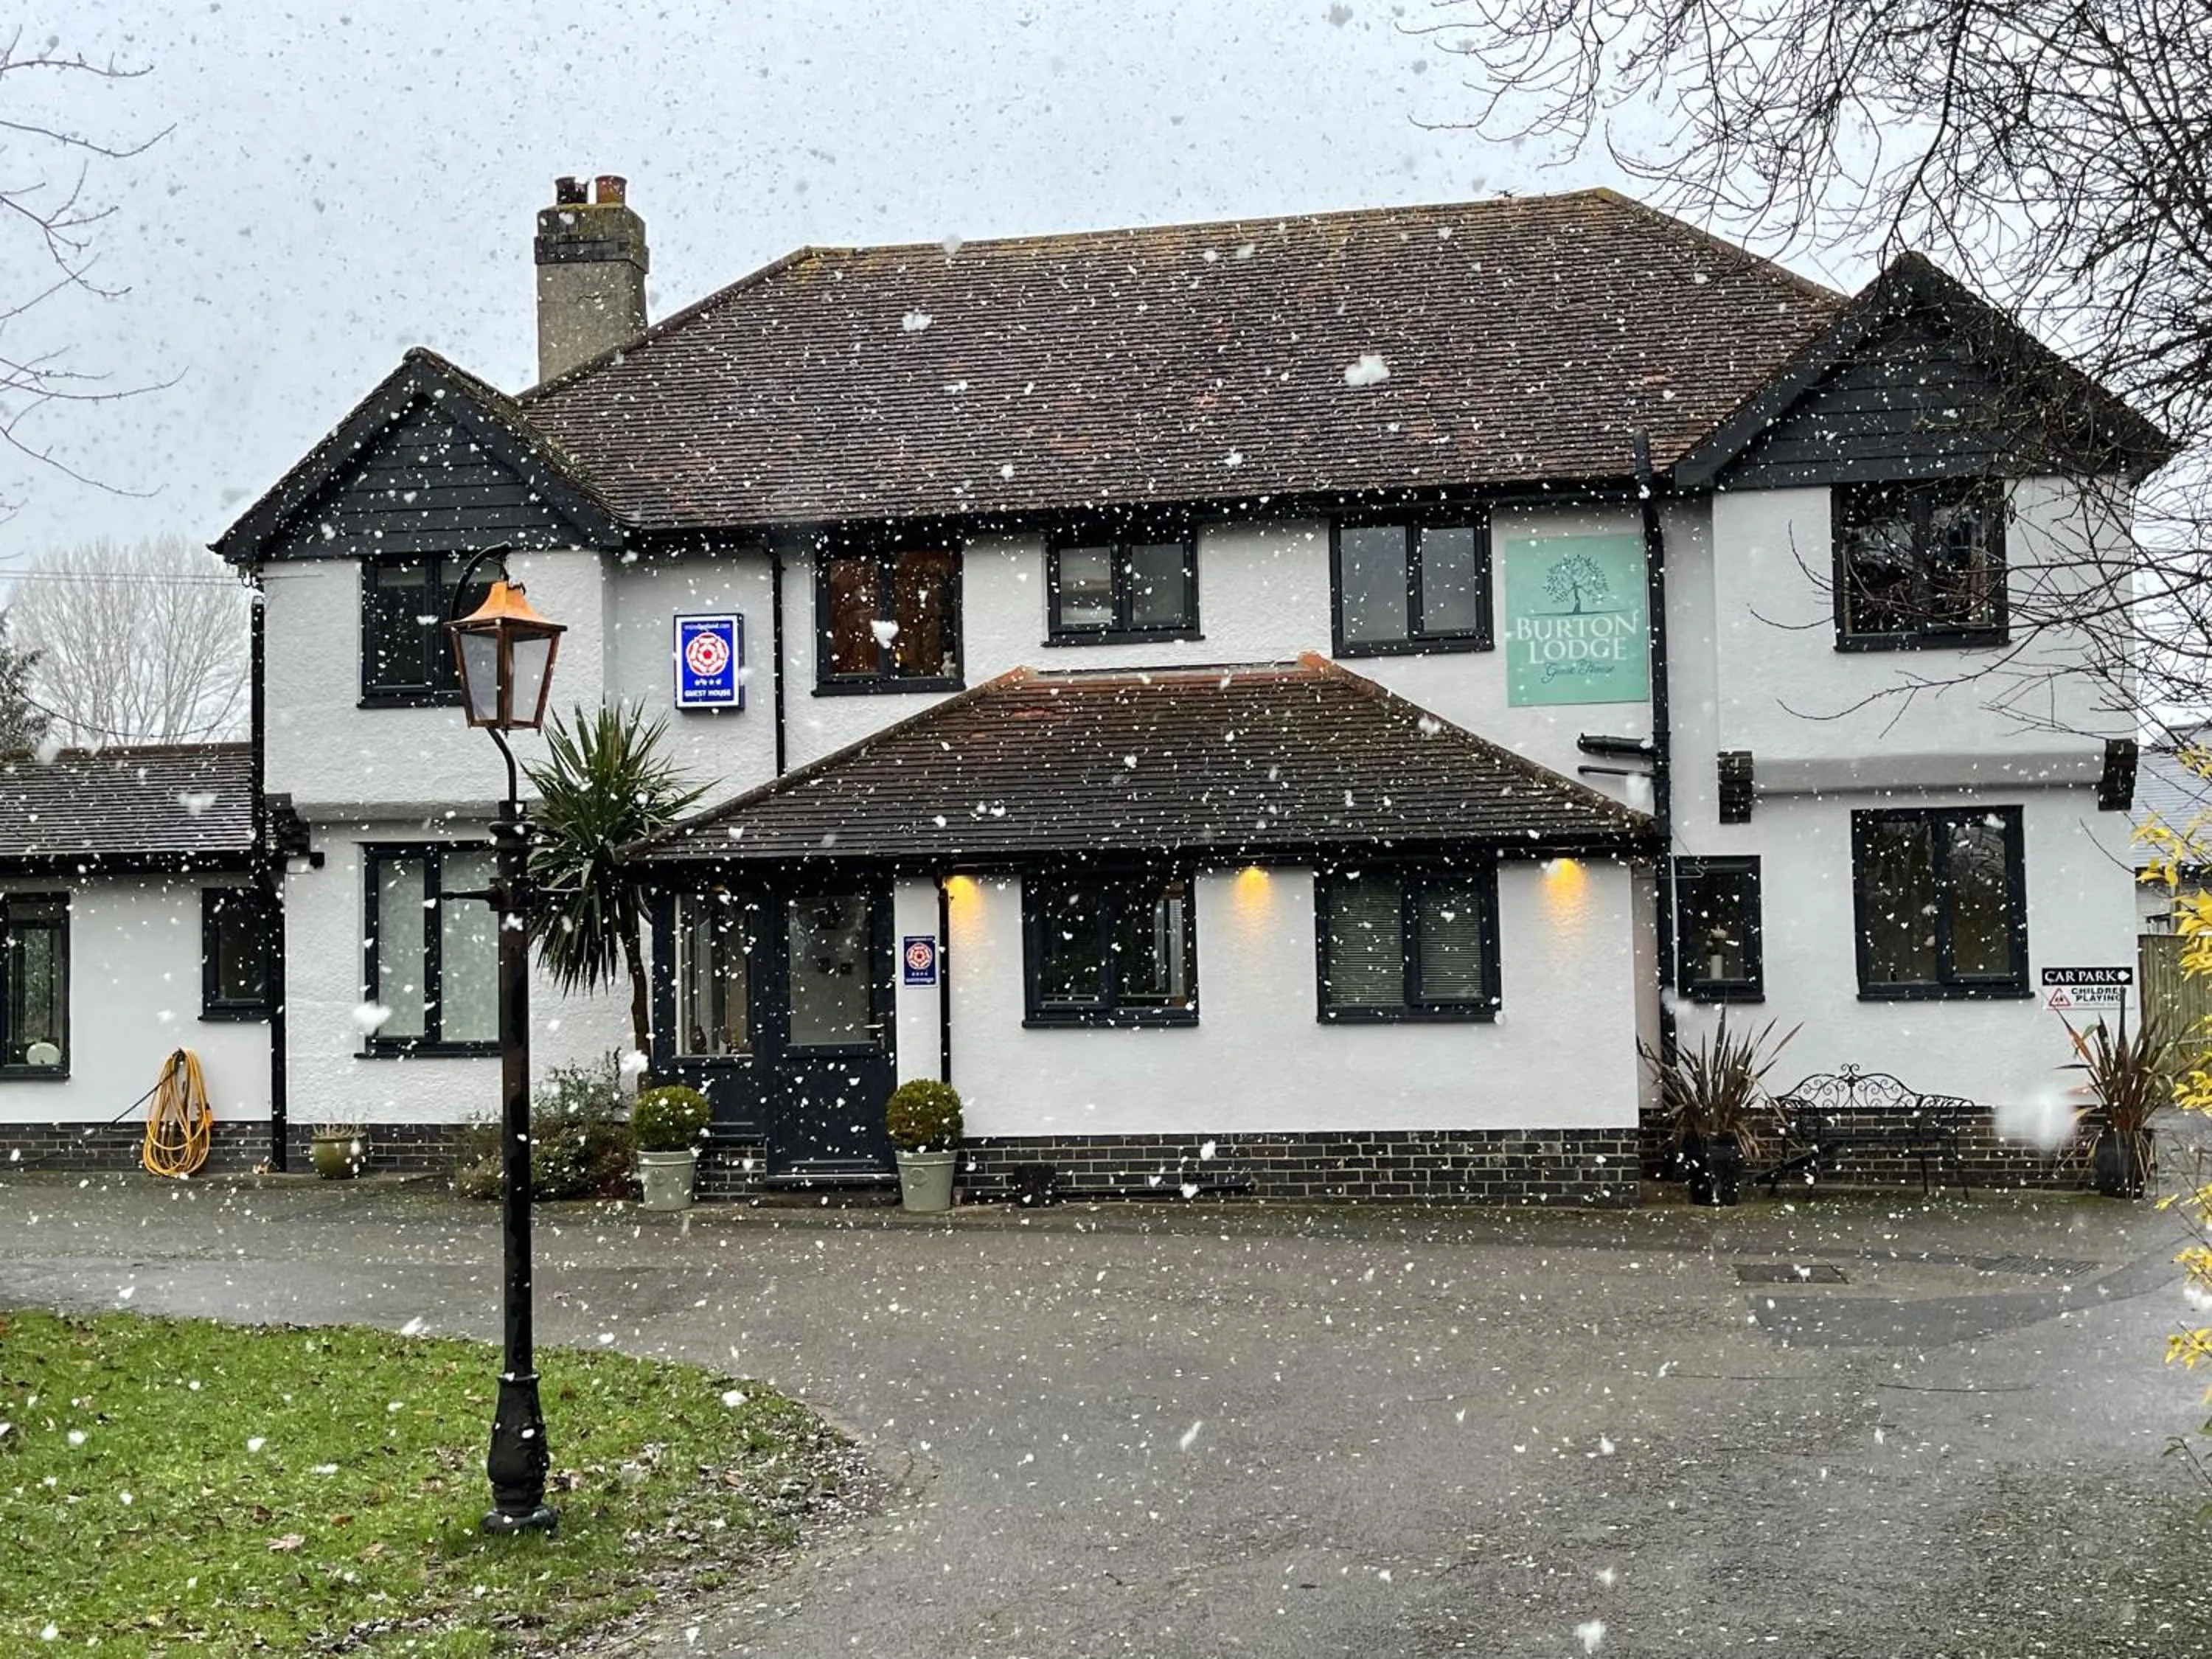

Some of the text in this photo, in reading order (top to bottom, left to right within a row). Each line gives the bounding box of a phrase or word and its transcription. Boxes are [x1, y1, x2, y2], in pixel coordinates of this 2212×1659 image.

[1517, 611, 1638, 641] BURTON
[1529, 637, 1627, 664] LODGE
[708, 689, 731, 697] HOUSE
[2045, 970, 2116, 983] CAR PARK
